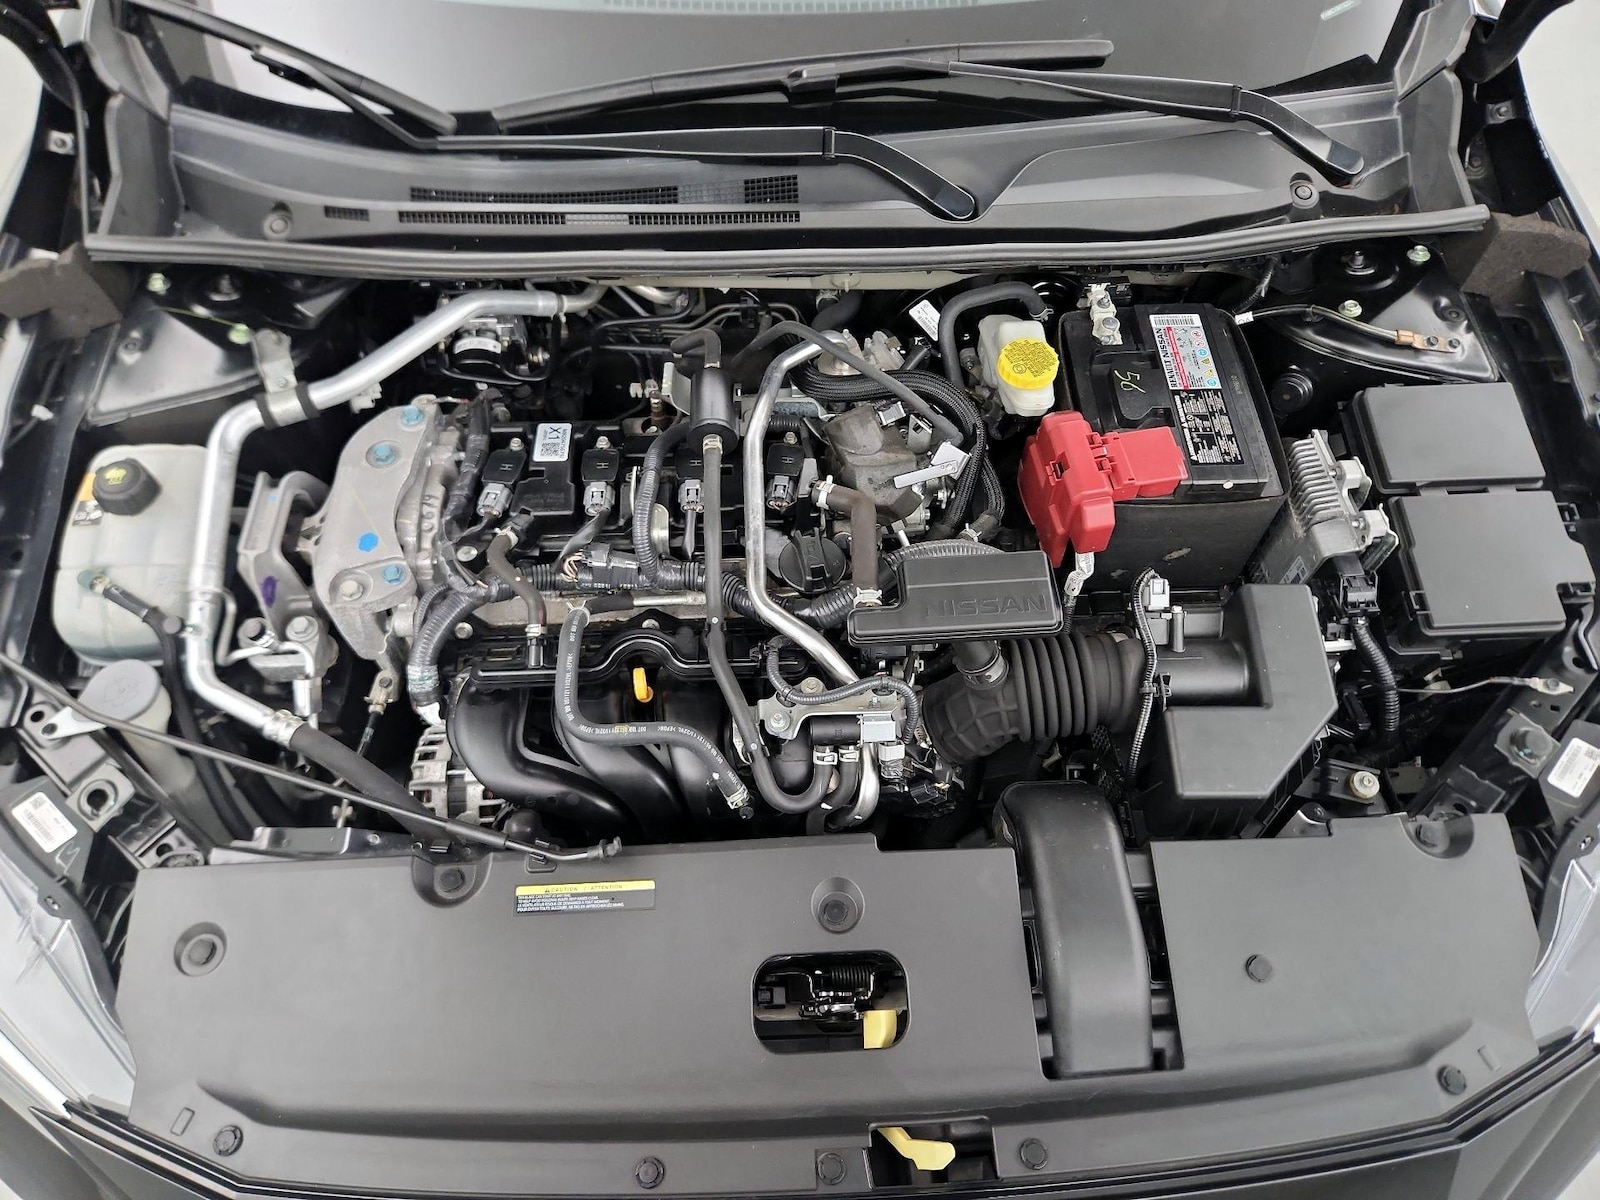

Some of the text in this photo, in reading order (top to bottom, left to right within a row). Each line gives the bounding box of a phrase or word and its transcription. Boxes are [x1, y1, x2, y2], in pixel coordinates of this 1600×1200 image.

[1155, 328, 1169, 358] NISSAN
[1164, 360, 1178, 388] RENAULT
[548, 426, 562, 440] X1
[926, 594, 1047, 619] NISSAN
